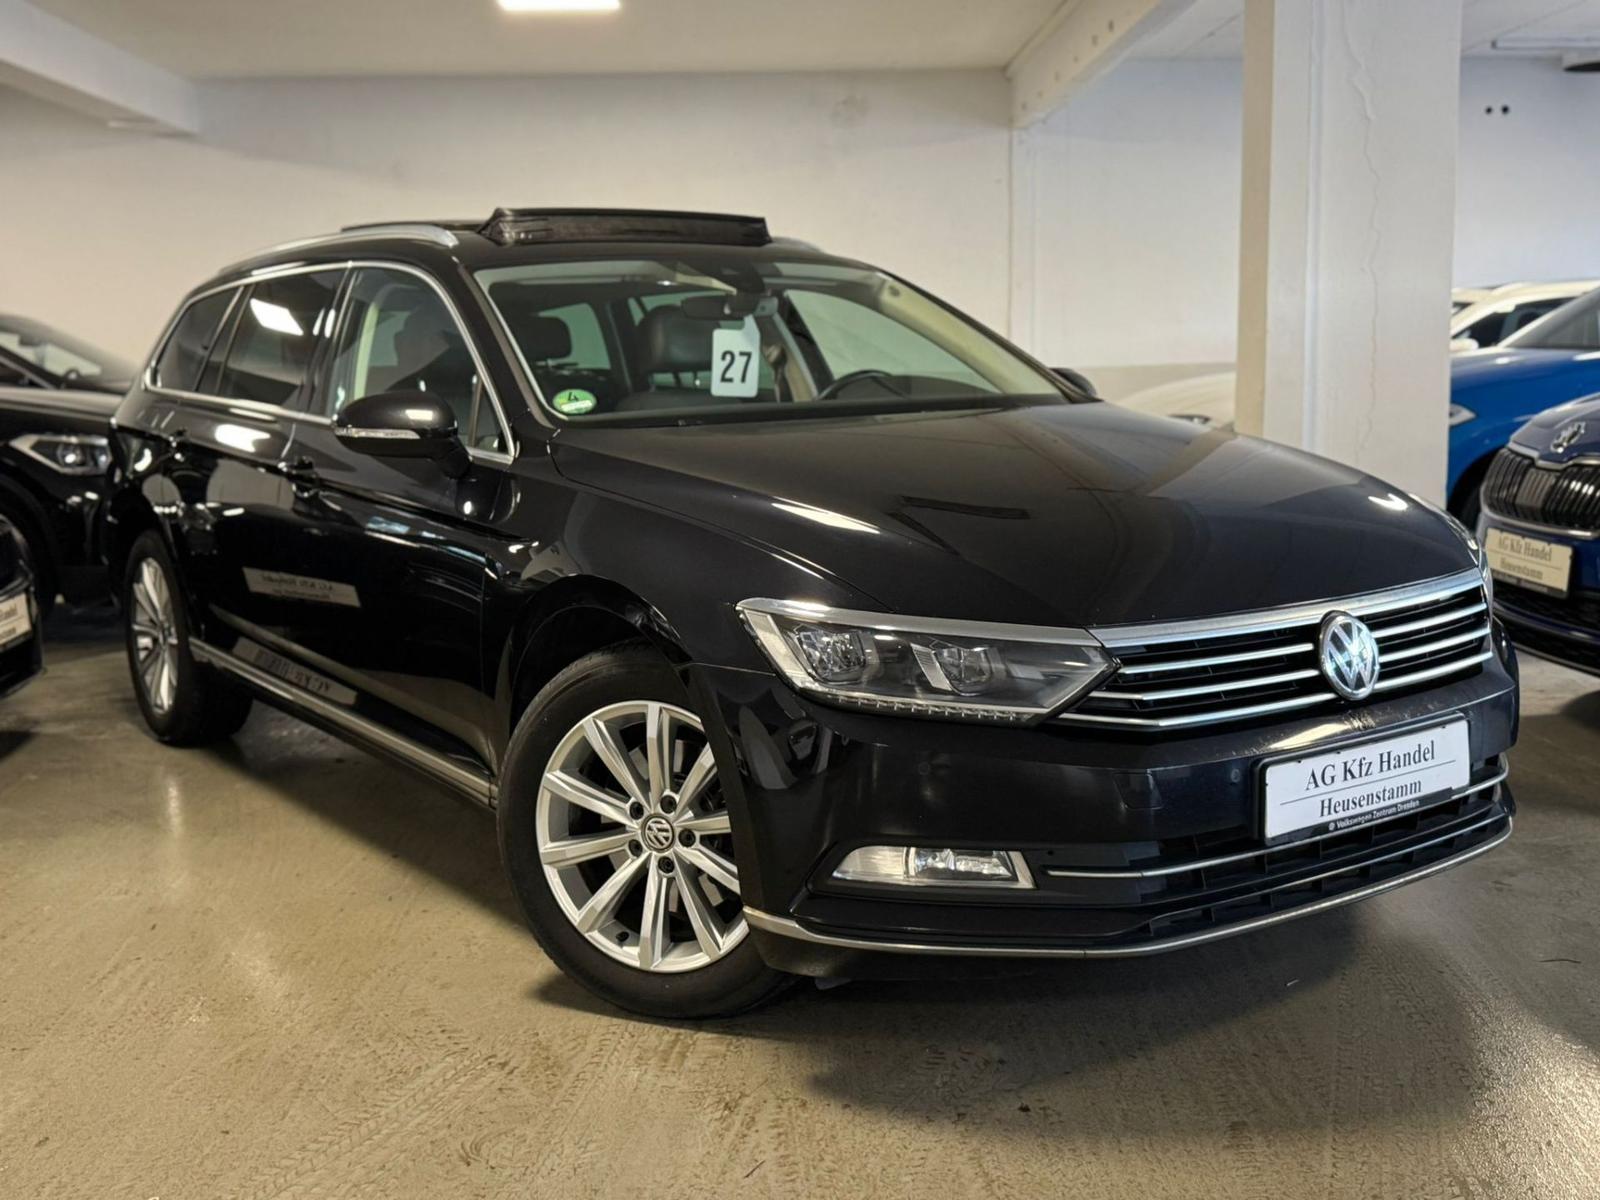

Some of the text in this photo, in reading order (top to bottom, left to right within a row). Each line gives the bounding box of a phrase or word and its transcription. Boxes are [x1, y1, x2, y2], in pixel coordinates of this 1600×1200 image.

[720, 350, 753, 383] 27
[1305, 740, 1435, 791] AG Kfz Handel
[1320, 779, 1422, 818] Heusenstamm
[1372, 806, 1397, 819] Zentrum
[1397, 800, 1420, 813] Dresden
